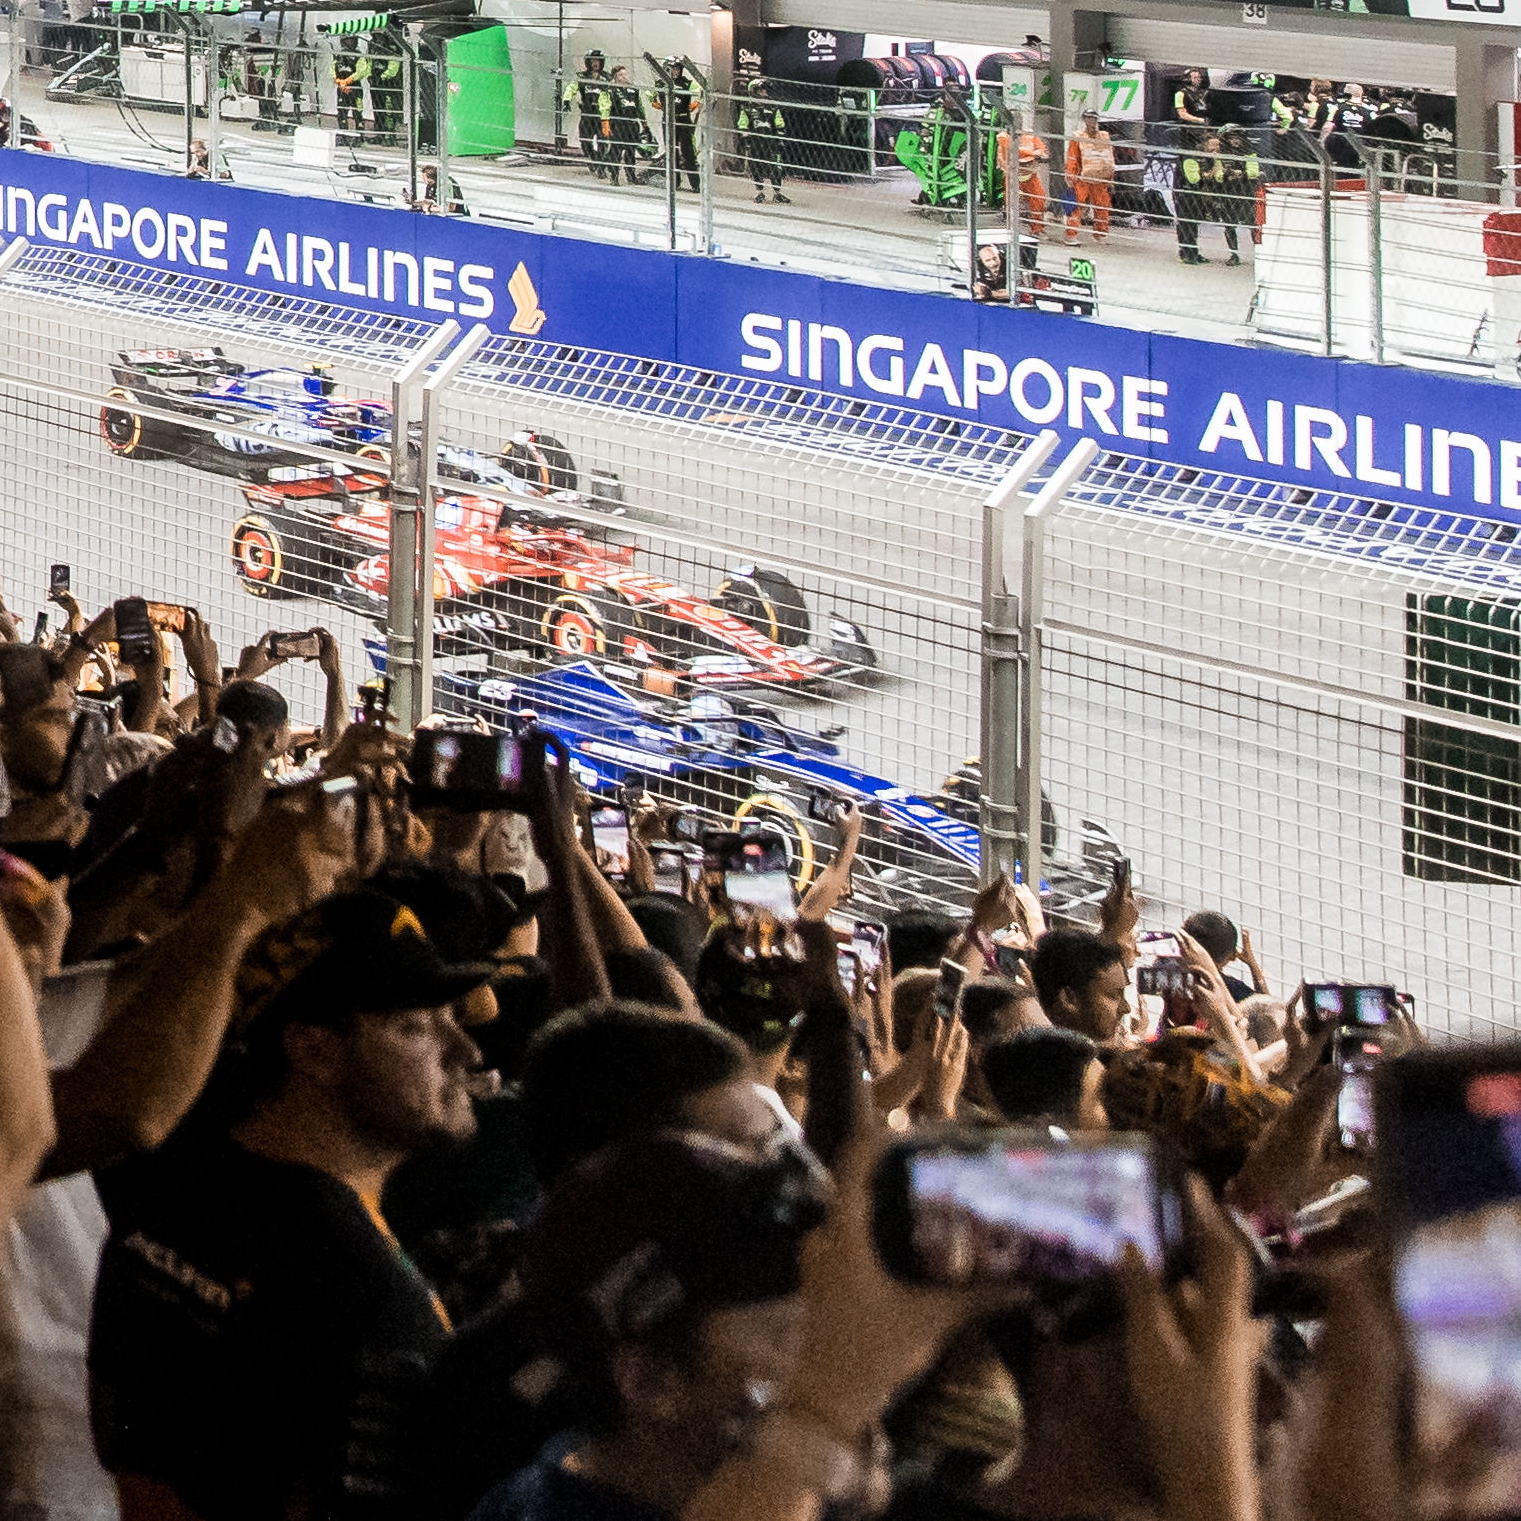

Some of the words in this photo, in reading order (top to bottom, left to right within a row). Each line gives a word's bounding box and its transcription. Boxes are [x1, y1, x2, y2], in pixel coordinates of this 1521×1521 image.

[1102, 79, 1140, 112] 77
[245, 228, 496, 320] AIRLINES
[1071, 260, 1091, 279] 20
[740, 312, 1171, 446] SINGAPORE
